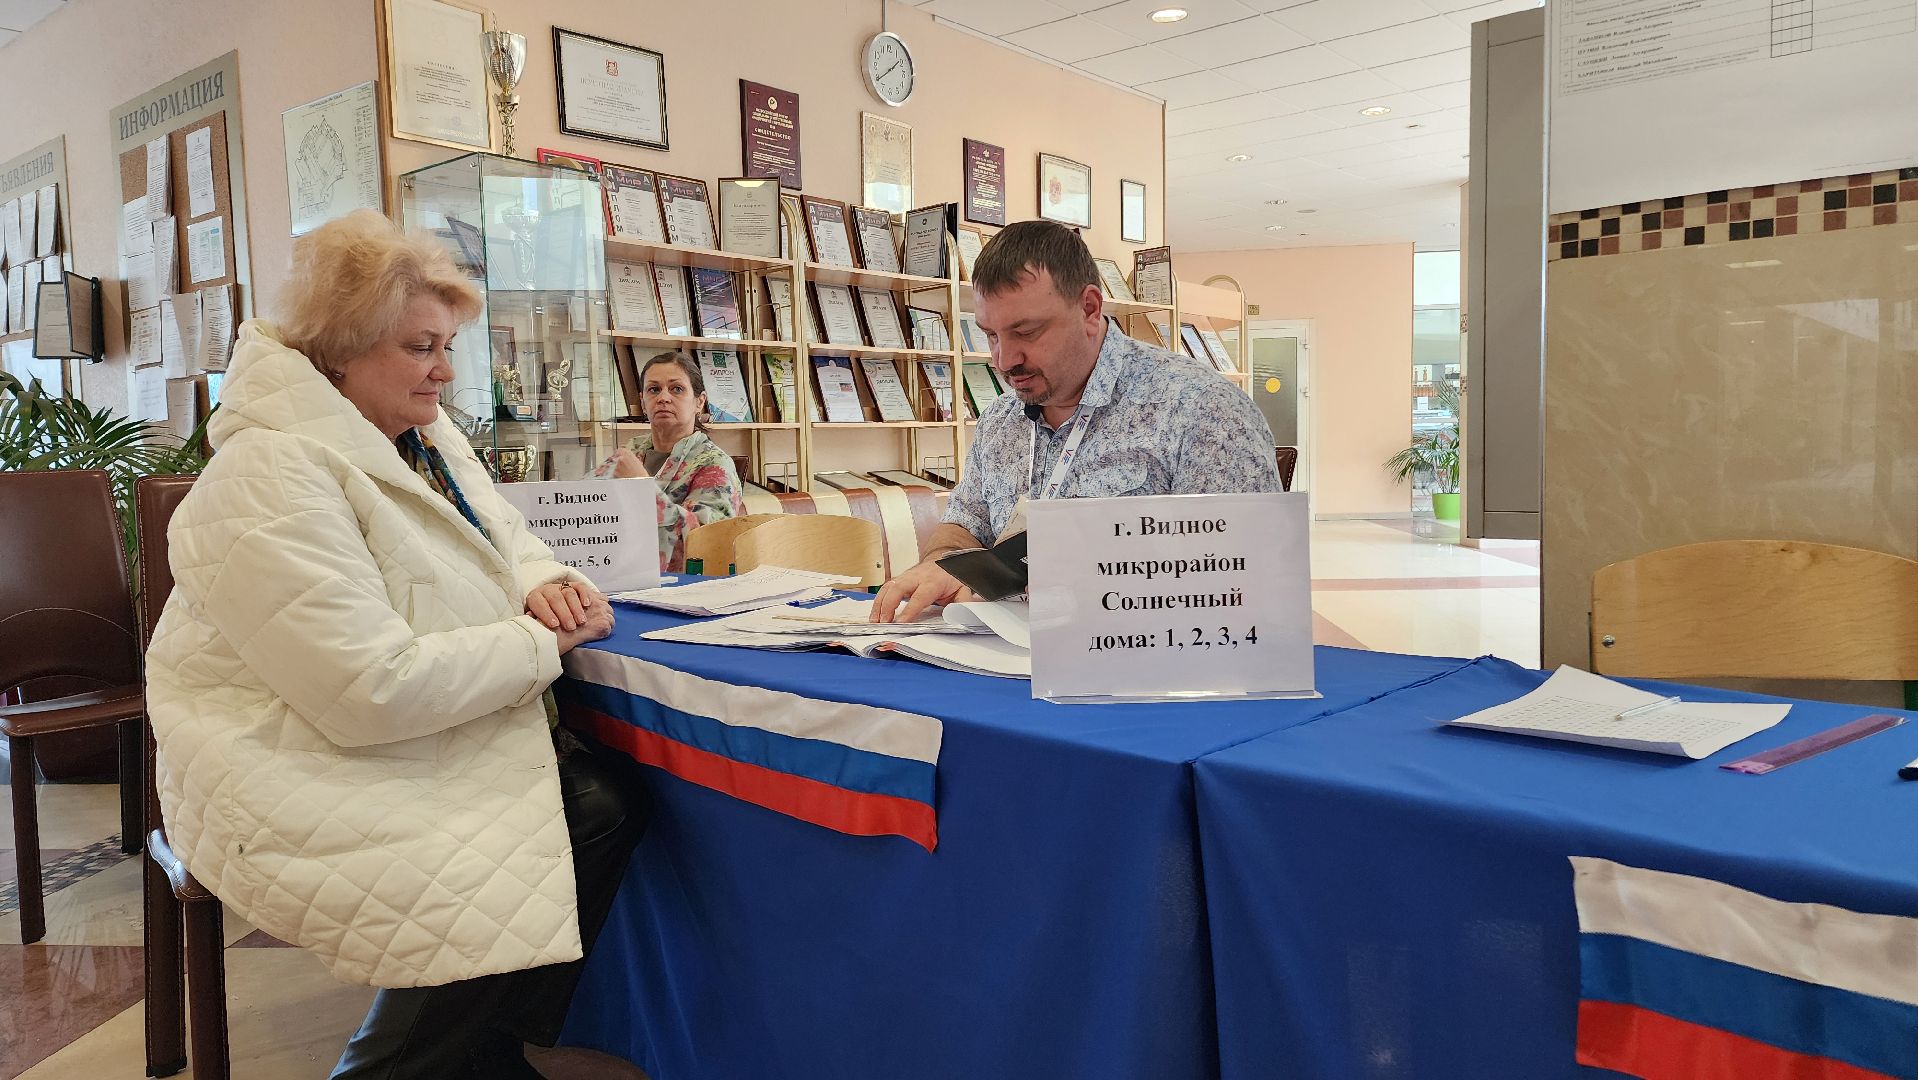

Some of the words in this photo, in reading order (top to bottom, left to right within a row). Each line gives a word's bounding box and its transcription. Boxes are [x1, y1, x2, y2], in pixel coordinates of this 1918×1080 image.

[119, 71, 224, 140] ИНФОРМАЦИЯ
[661, 179, 679, 242] ДИПЛОМ
[538, 496, 549, 505] г.
[554, 492, 608, 505] Видное
[528, 513, 619, 530] микрорайон
[1113, 522, 1132, 537] г.
[1140, 516, 1227, 537] Видное
[538, 532, 618, 547] олнечный
[587, 555, 600, 569] 5,
[603, 554, 611, 566] 6
[1097, 553, 1246, 579] микрорайон
[1101, 588, 1243, 611] Солнечный
[1088, 634, 1156, 652] дома:
[1166, 629, 1184, 651] 1,
[1191, 627, 1211, 650] 2,
[1217, 626, 1238, 649] 3,
[1245, 625, 1258, 645] 4
